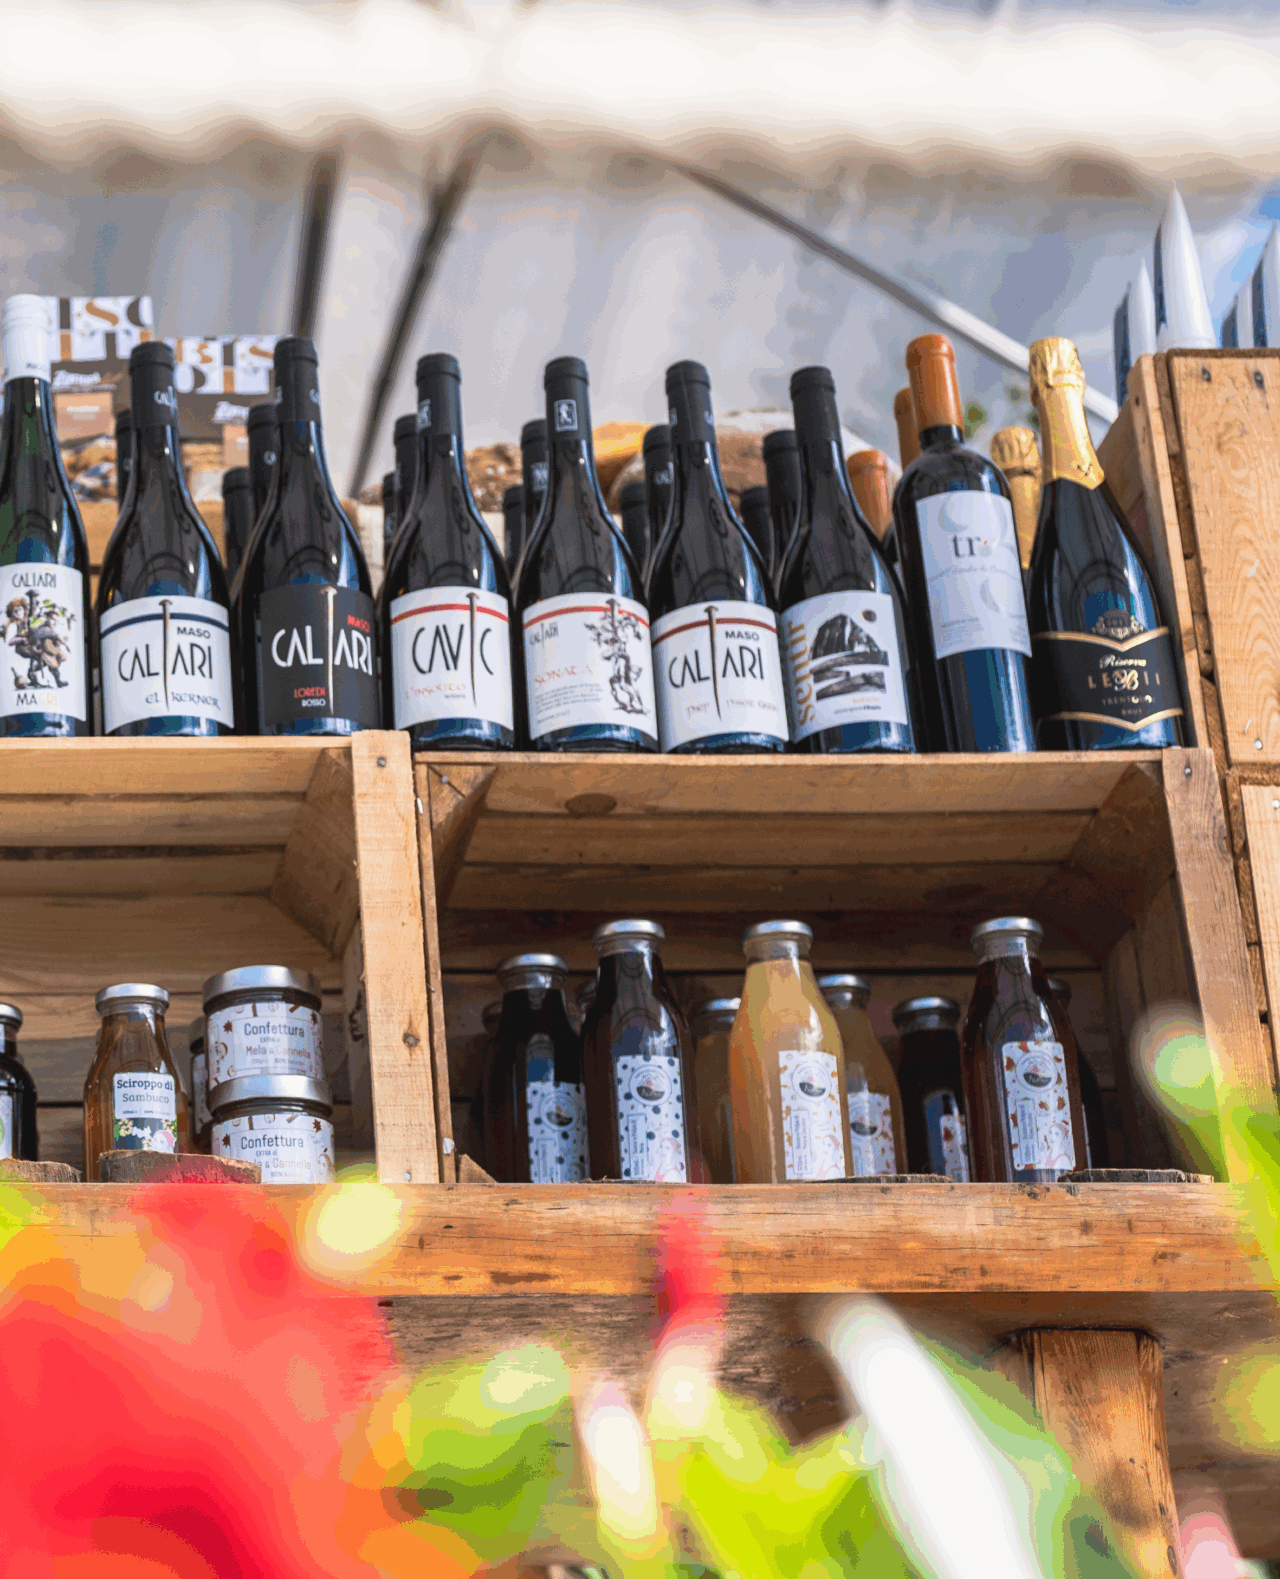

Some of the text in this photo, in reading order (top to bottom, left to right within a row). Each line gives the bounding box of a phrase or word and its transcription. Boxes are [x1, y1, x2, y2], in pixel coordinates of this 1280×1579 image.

[176, 626, 211, 639] MASO
[725, 630, 759, 641] MASO
[244, 1021, 305, 1038] Confettura
[246, 1046, 267, 1055] Mela
[117, 1078, 173, 1091] Sciroppo di
[122, 1092, 169, 1104] Sambuco
[241, 1134, 304, 1150] Confettura
[272, 1157, 311, 1170] Cannella
